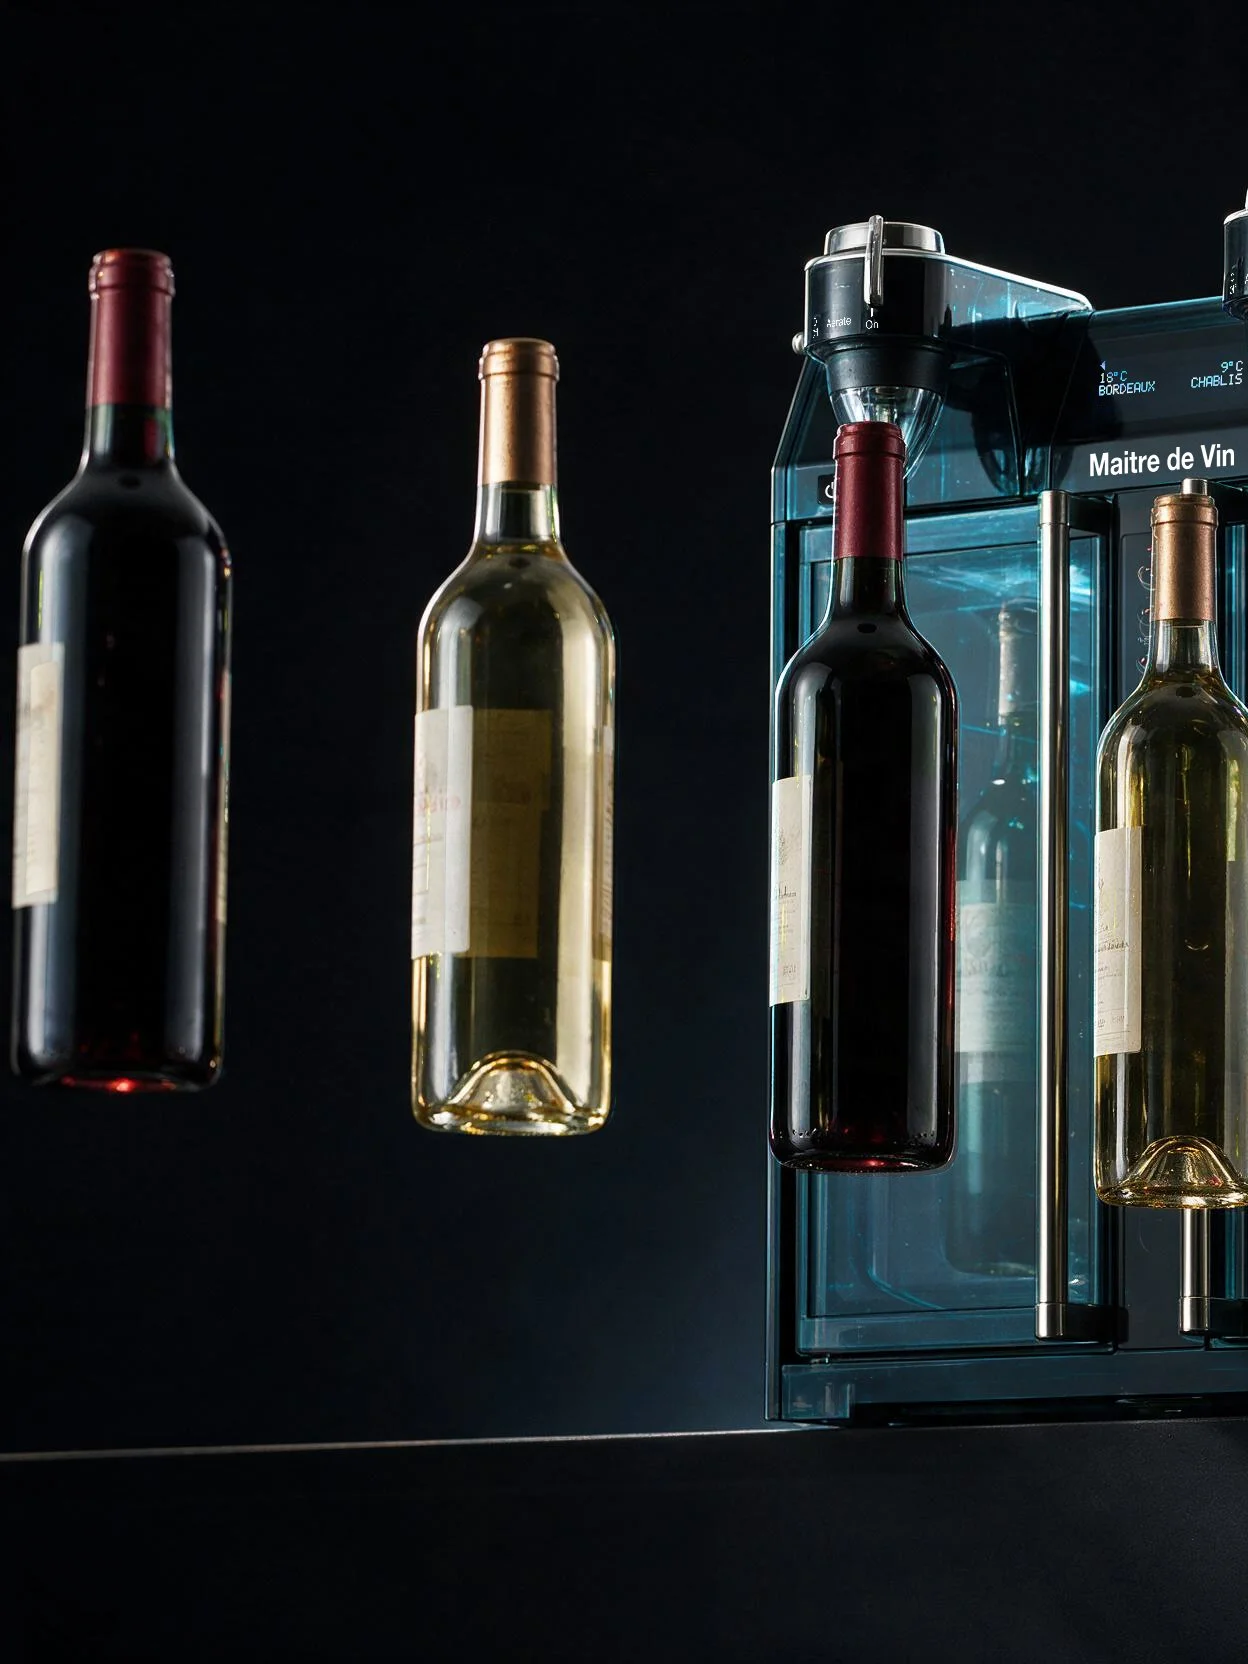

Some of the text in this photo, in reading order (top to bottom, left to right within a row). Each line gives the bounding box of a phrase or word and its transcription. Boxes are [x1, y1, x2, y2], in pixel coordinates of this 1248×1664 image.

[826, 316, 852, 329] Aerate
[865, 319, 879, 330] On
[1098, 380, 1156, 397] BORDEAUX
[1190, 373, 1243, 389] CHABLIS
[1089, 443, 1236, 477] Maitre de Vin
